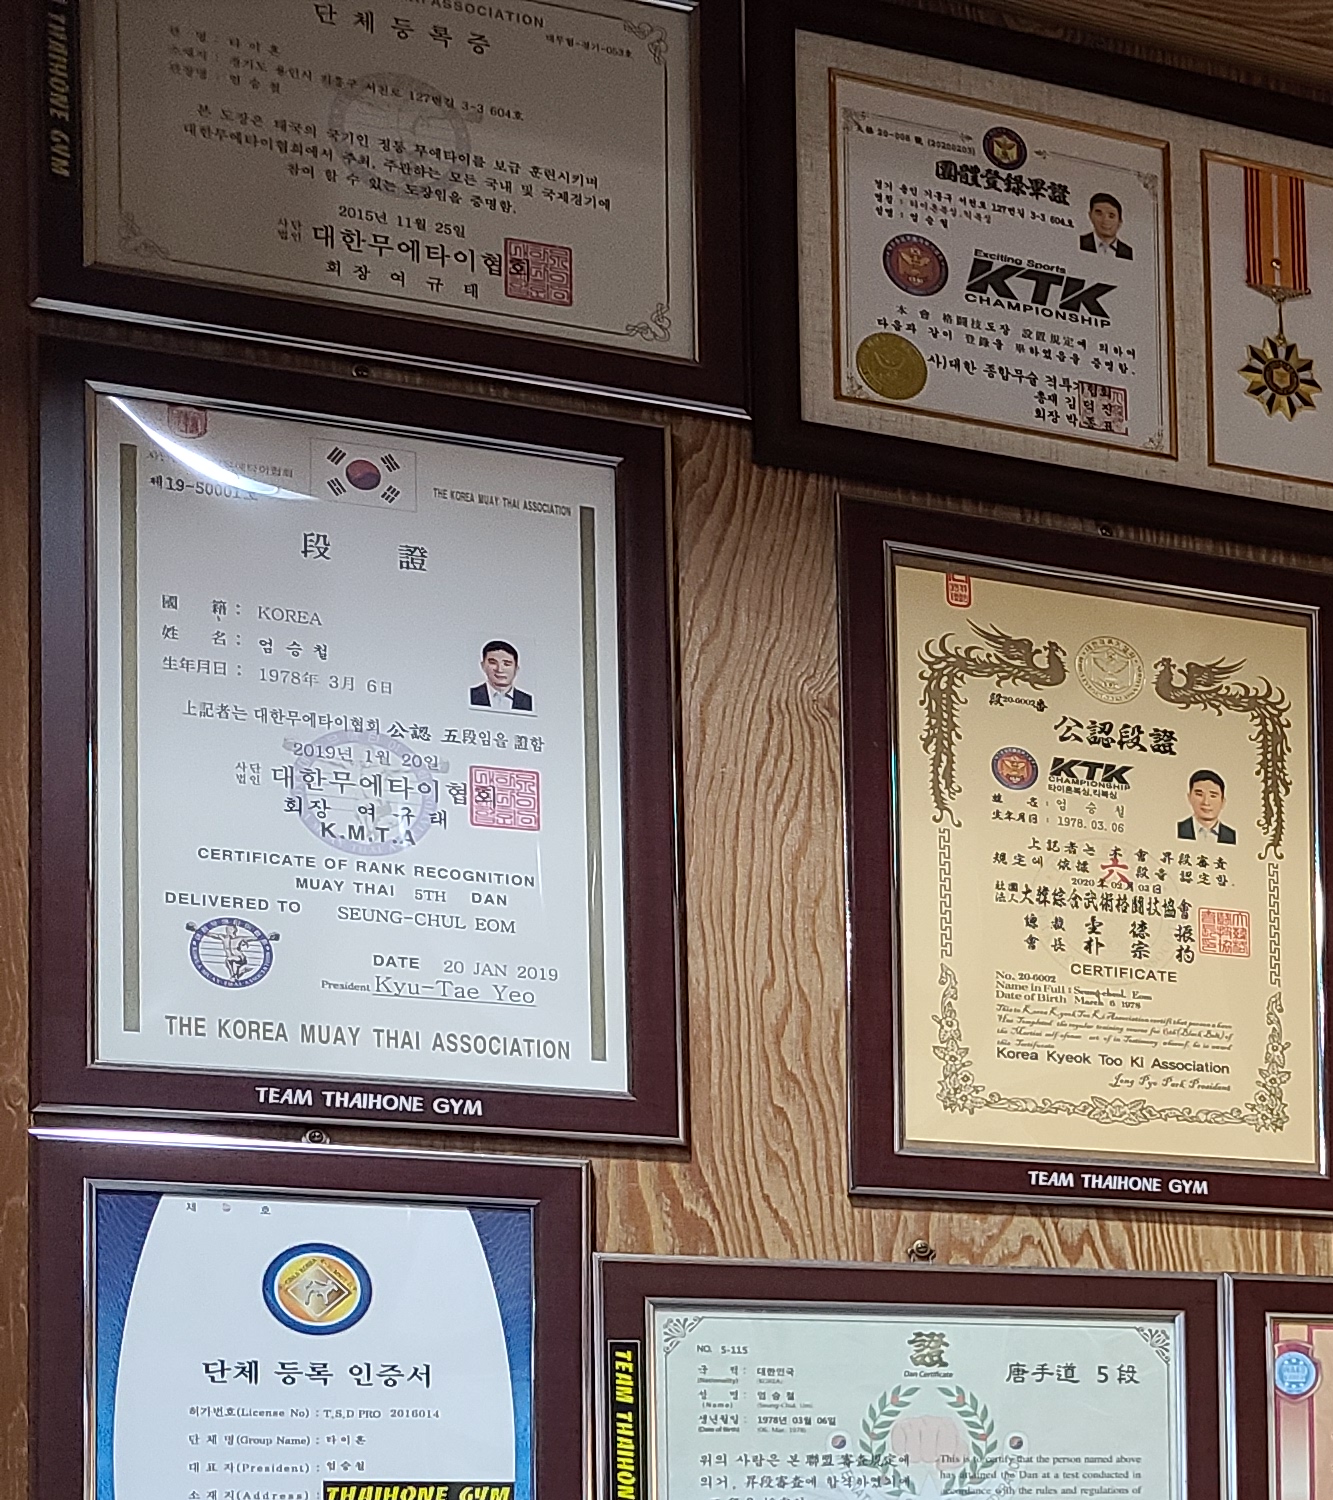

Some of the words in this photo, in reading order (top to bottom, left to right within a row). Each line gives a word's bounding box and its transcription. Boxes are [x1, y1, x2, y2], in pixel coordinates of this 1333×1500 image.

[974, 248, 1022, 268] Exciting
[1026, 259, 1067, 275] Sports
[966, 257, 1118, 318] KTK
[964, 292, 1111, 328] CHAMPIONSHIP
[258, 605, 323, 626] KOREA
[1050, 756, 1134, 784] KTK
[272, 765, 496, 808] 대한무에타이협회
[198, 848, 316, 871] CERTIFICATE
[324, 857, 348, 872] OF
[356, 862, 406, 877] RANK
[414, 866, 535, 887] RECOGNITION
[165, 892, 269, 913] DELIVERED
[279, 900, 301, 914] TO
[295, 877, 345, 894] MUAY
[353, 882, 395, 897] THAI
[414, 889, 447, 903] 5TH
[472, 892, 508, 906] DAN
[338, 905, 466, 930] SEUNG-CHUL
[475, 917, 516, 934] EOM
[373, 954, 420, 970] DATE
[443, 960, 464, 975] 20
[473, 963, 509, 978] JAN
[517, 965, 559, 982] 2019
[1070, 962, 1177, 984] CERTIFICATE
[322, 979, 371, 993] President
[375, 974, 480, 1000] Kyu-Tae
[493, 983, 535, 1006] Yeo
[165, 1016, 206, 1037] THE
[218, 1019, 288, 1043] KOREA
[301, 1024, 361, 1048] MUAY
[374, 1030, 420, 1052] THAI
[433, 1034, 571, 1060] ASSOCIATION
[996, 1047, 1041, 1063] Korea
[1046, 1049, 1091, 1069] Kyeok
[1099, 1054, 1124, 1069] Too
[1130, 1056, 1146, 1070] Ki
[1152, 1058, 1230, 1075] Association
[256, 1086, 313, 1106] TEAM
[322, 1091, 424, 1113] THAIHONE
[433, 1098, 483, 1116] GYM
[1029, 1170, 1075, 1190] TEAM
[1080, 1173, 1161, 1193] THAIHONE
[1168, 1178, 1209, 1196] GYM
[202, 1359, 260, 1386] 단체
[274, 1361, 334, 1386] 등록
[348, 1362, 432, 1389] 인증서
[614, 1349, 634, 1402] TEAM
[1006, 1362, 1080, 1385] 唐手道
